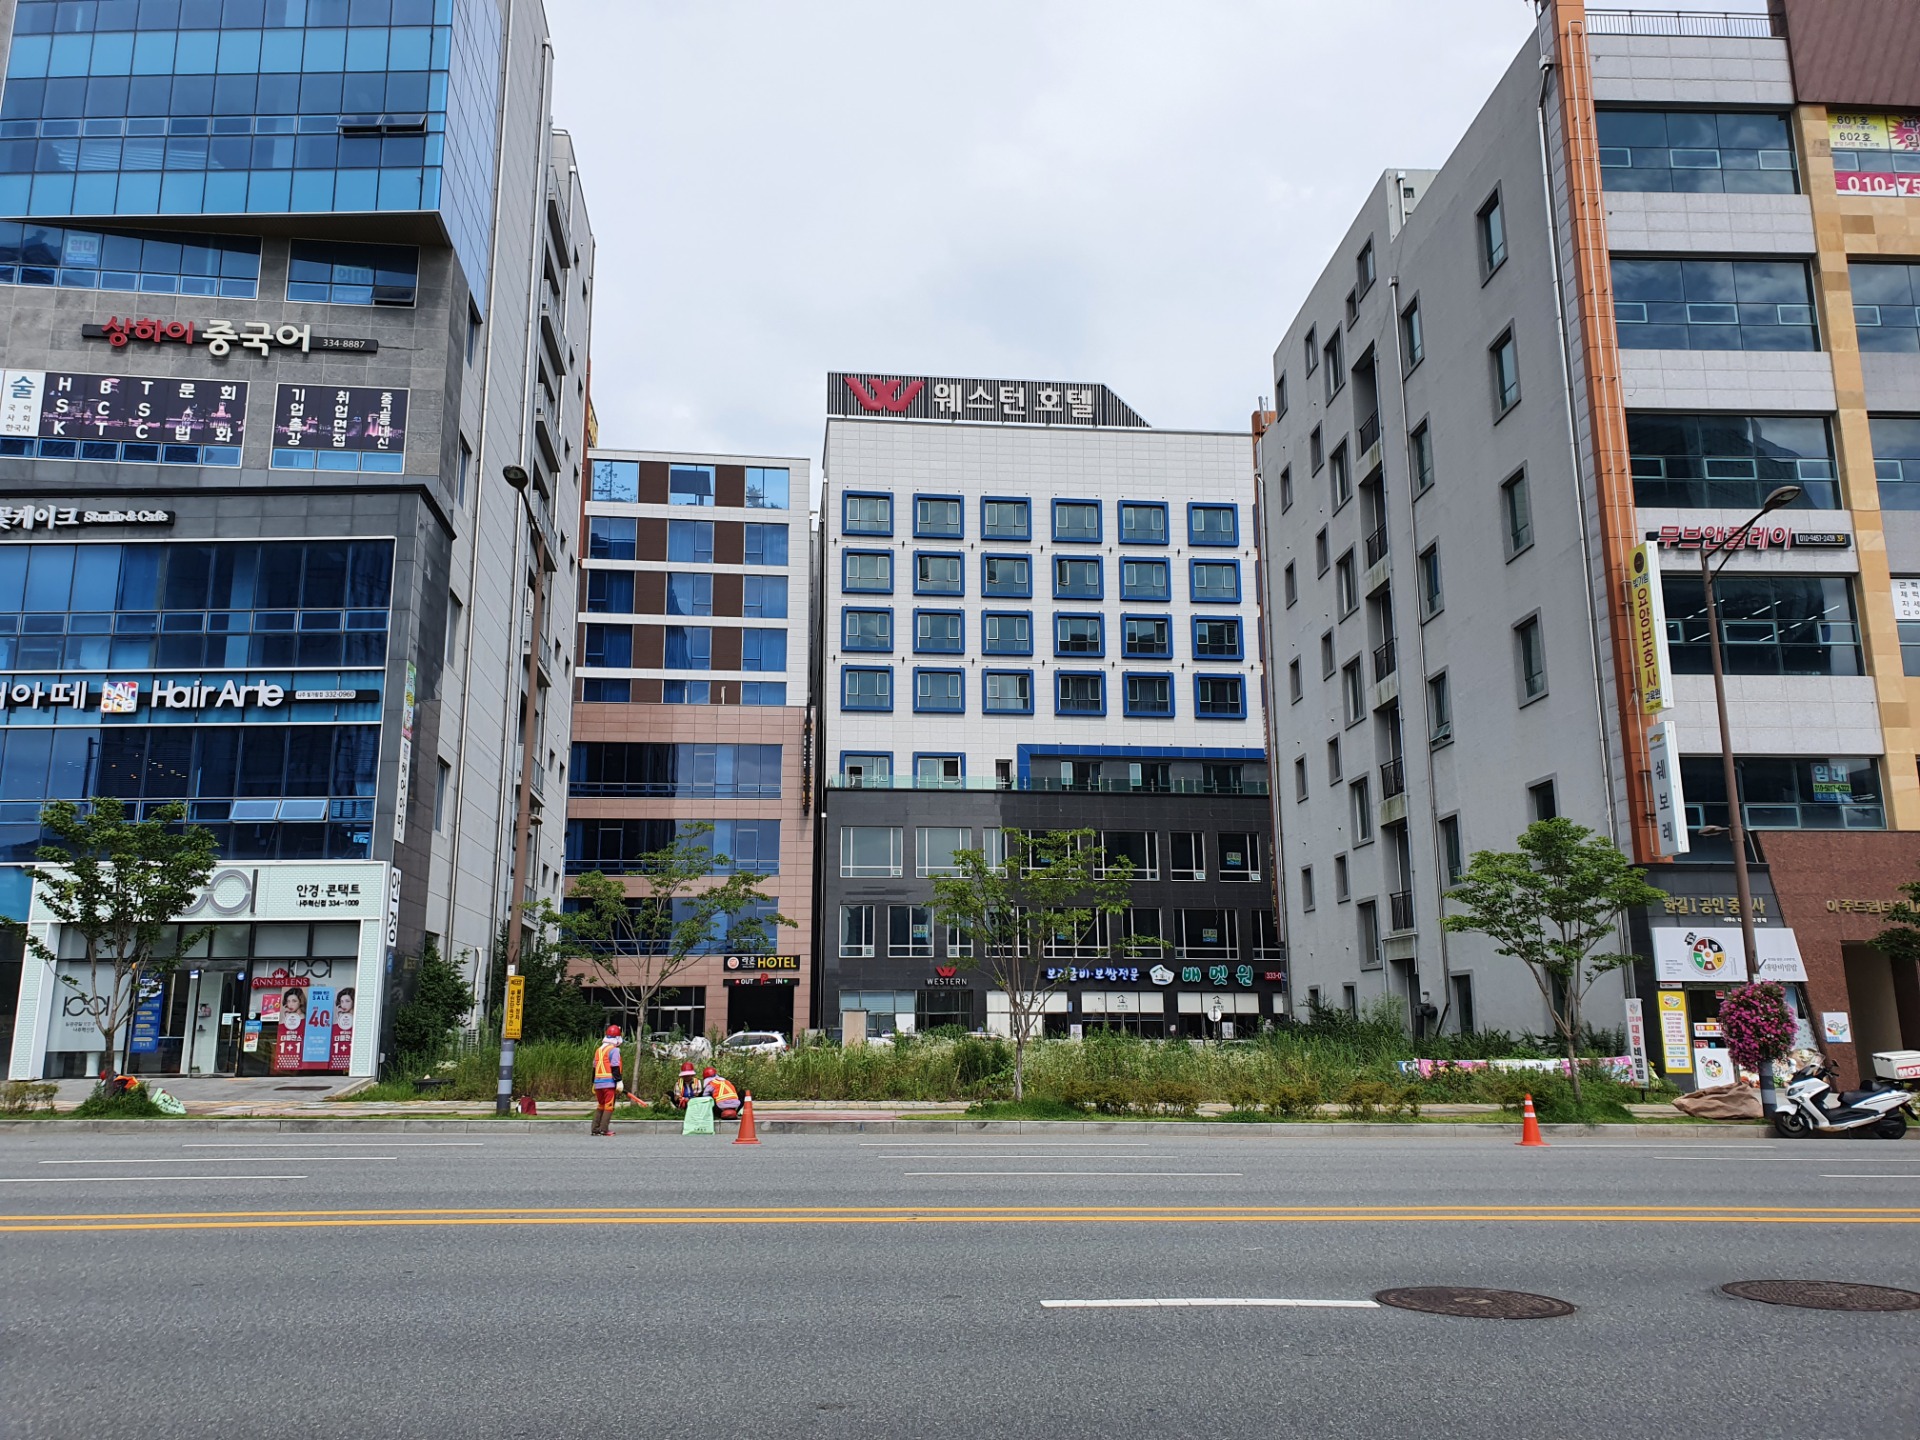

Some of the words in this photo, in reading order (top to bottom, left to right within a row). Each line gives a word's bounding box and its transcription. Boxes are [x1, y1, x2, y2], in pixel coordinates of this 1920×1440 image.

[1837, 115, 1869, 125] 601호
[1840, 132, 1872, 141] 602호
[102, 316, 194, 347] 상하이
[202, 320, 311, 357] 중국어
[322, 338, 366, 349] 334-8887
[10, 376, 36, 399] 술
[933, 384, 1026, 415] 웨스턴
[1035, 388, 1094, 418] 호텔
[287, 388, 306, 446] 기업출강
[332, 390, 350, 448] 취업면접
[377, 392, 393, 449] 중고등내신
[137, 510, 169, 522] Cafe
[1658, 525, 1792, 550] 무브앤플레이
[1638, 588, 1657, 688] 요양보호사
[1814, 765, 1848, 782] 임대
[1655, 759, 1674, 842] 쉐보레
[388, 871, 400, 943] 안경
[1664, 896, 1688, 915] 한길
[1699, 896, 1766, 915] 공인중사
[757, 956, 797, 969] HOTEL
[252, 978, 274, 986] ANN
[285, 978, 309, 986] LENS
[926, 977, 968, 986] WESTERN
[279, 1042, 302, 1054] 1+1
[1631, 1024, 1645, 1080] 대왕비빔밥
